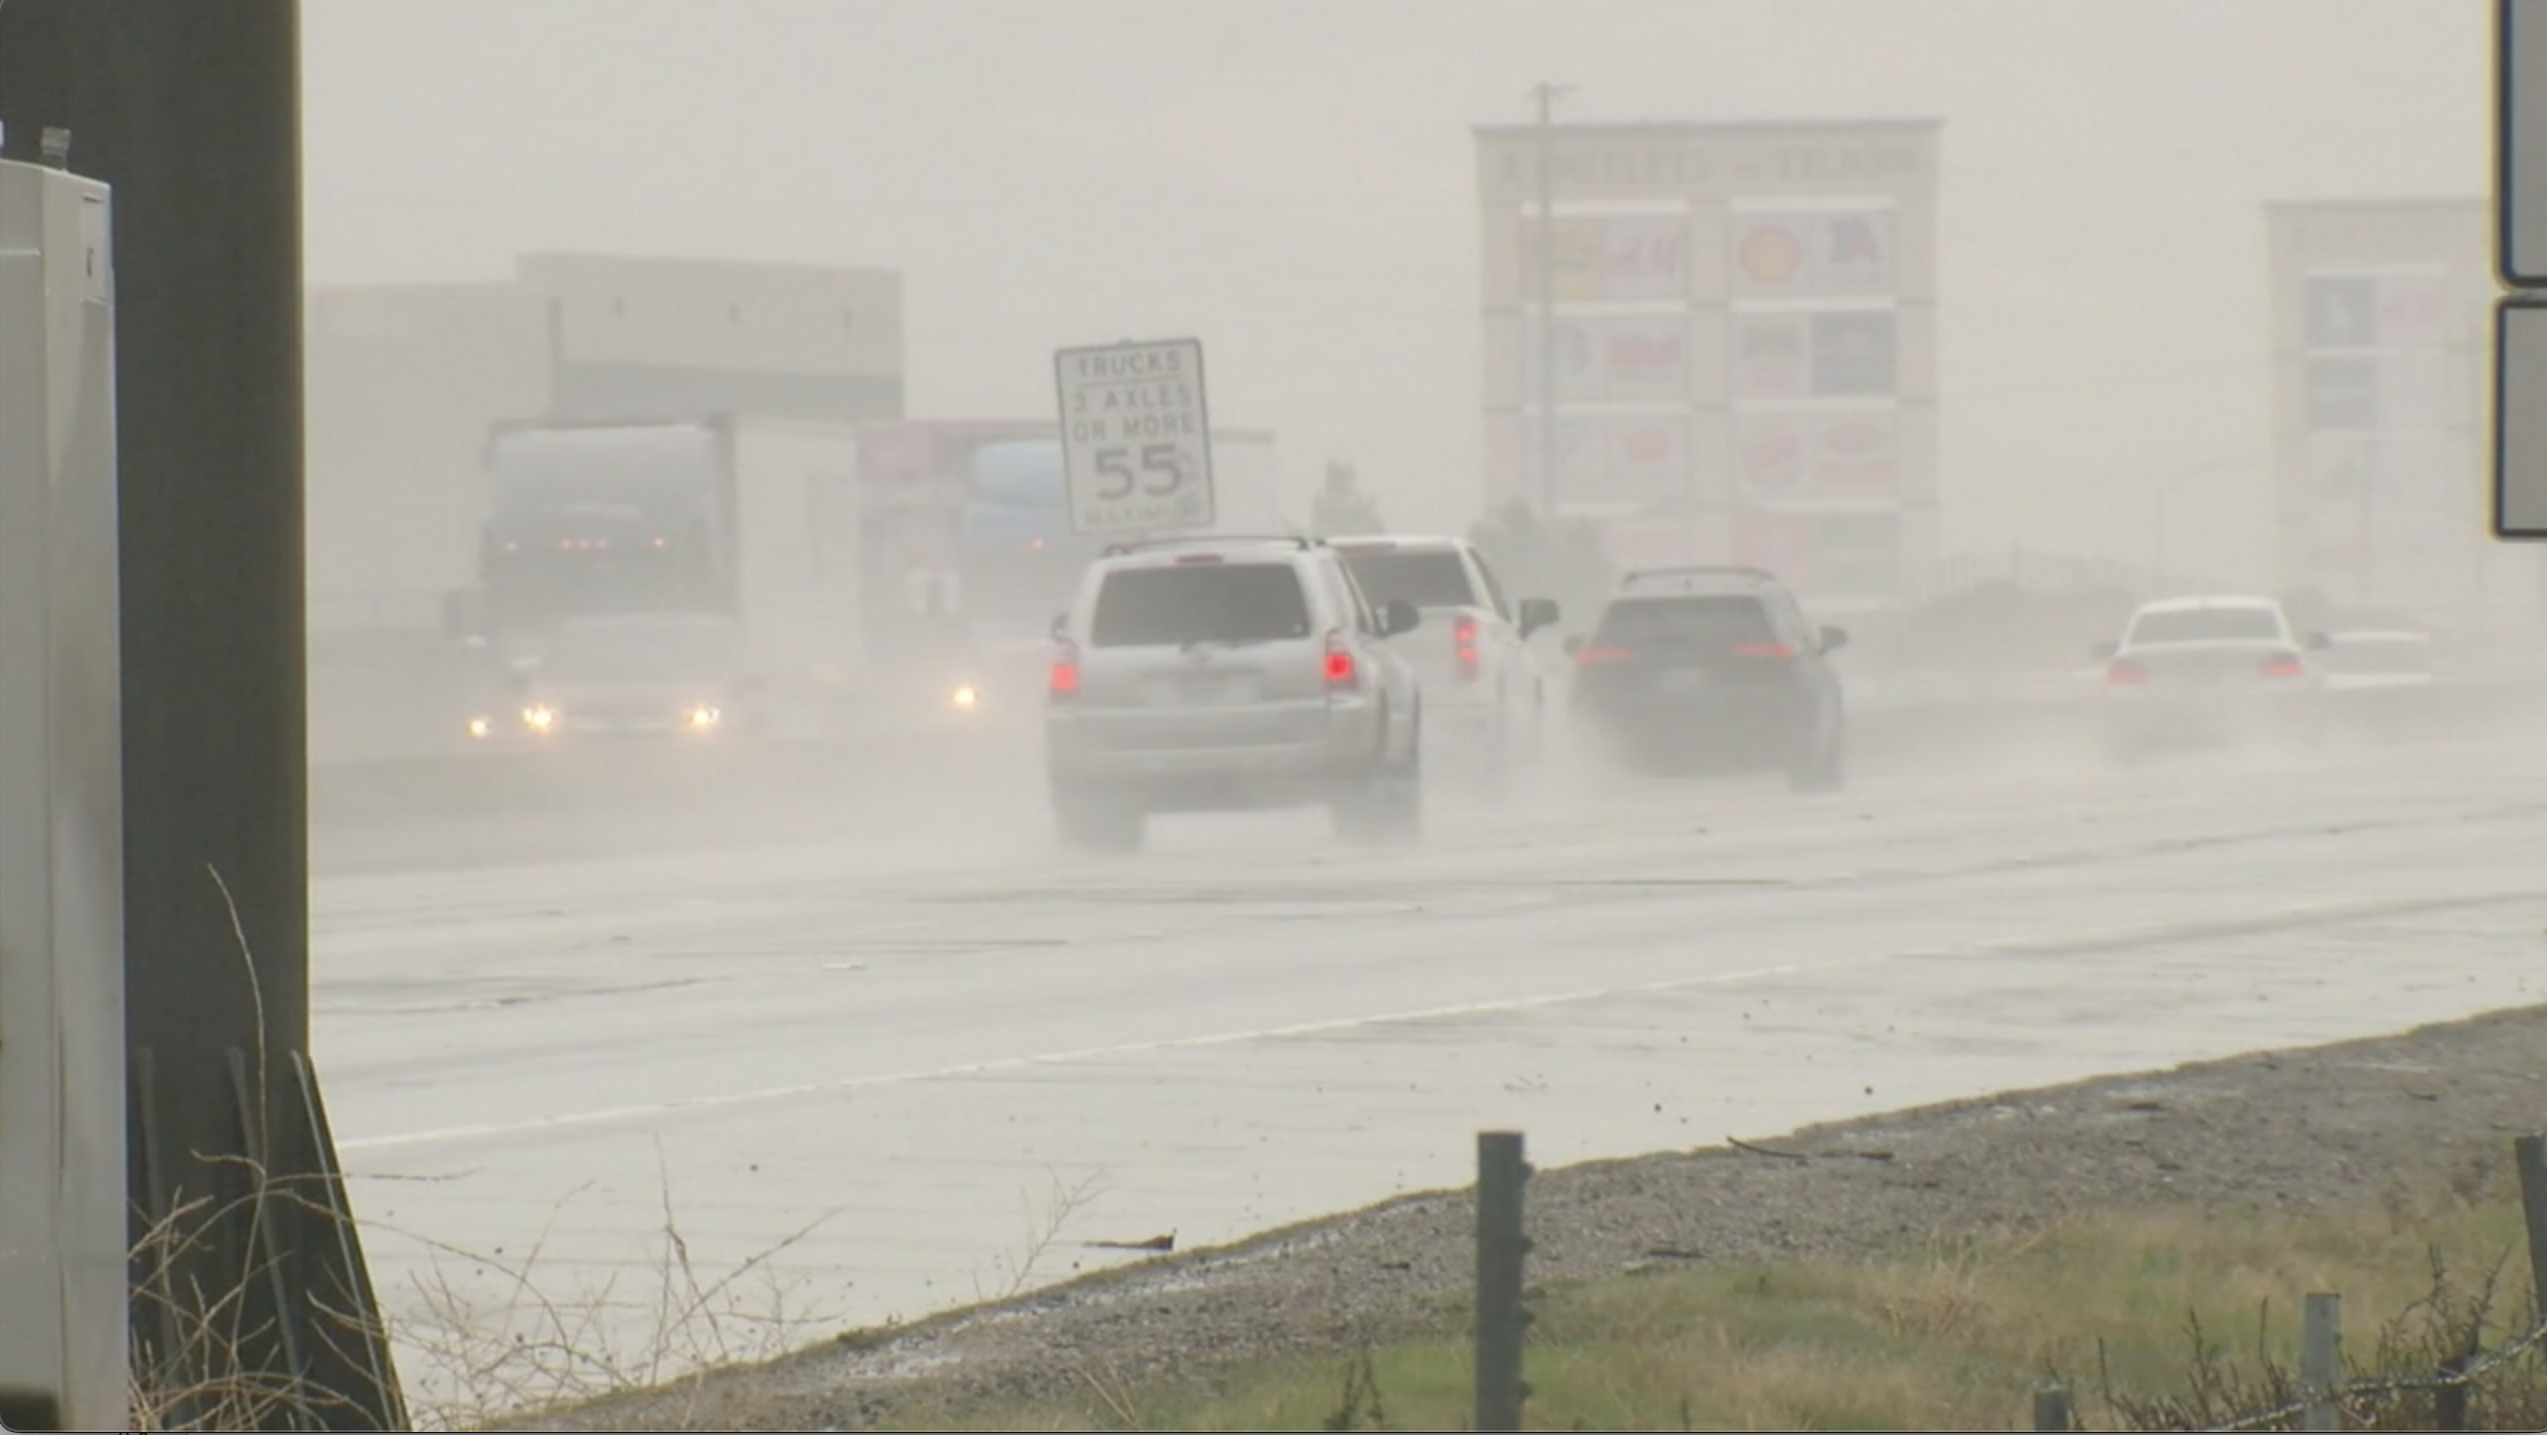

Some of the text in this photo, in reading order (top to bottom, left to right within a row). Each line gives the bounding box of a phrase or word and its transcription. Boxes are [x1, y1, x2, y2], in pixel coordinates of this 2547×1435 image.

[1077, 350, 1182, 378] TRUCKS
[1072, 384, 1193, 413] 3 AXLES
[1073, 412, 1197, 442] OR MORE
[1094, 443, 1183, 502] 55
